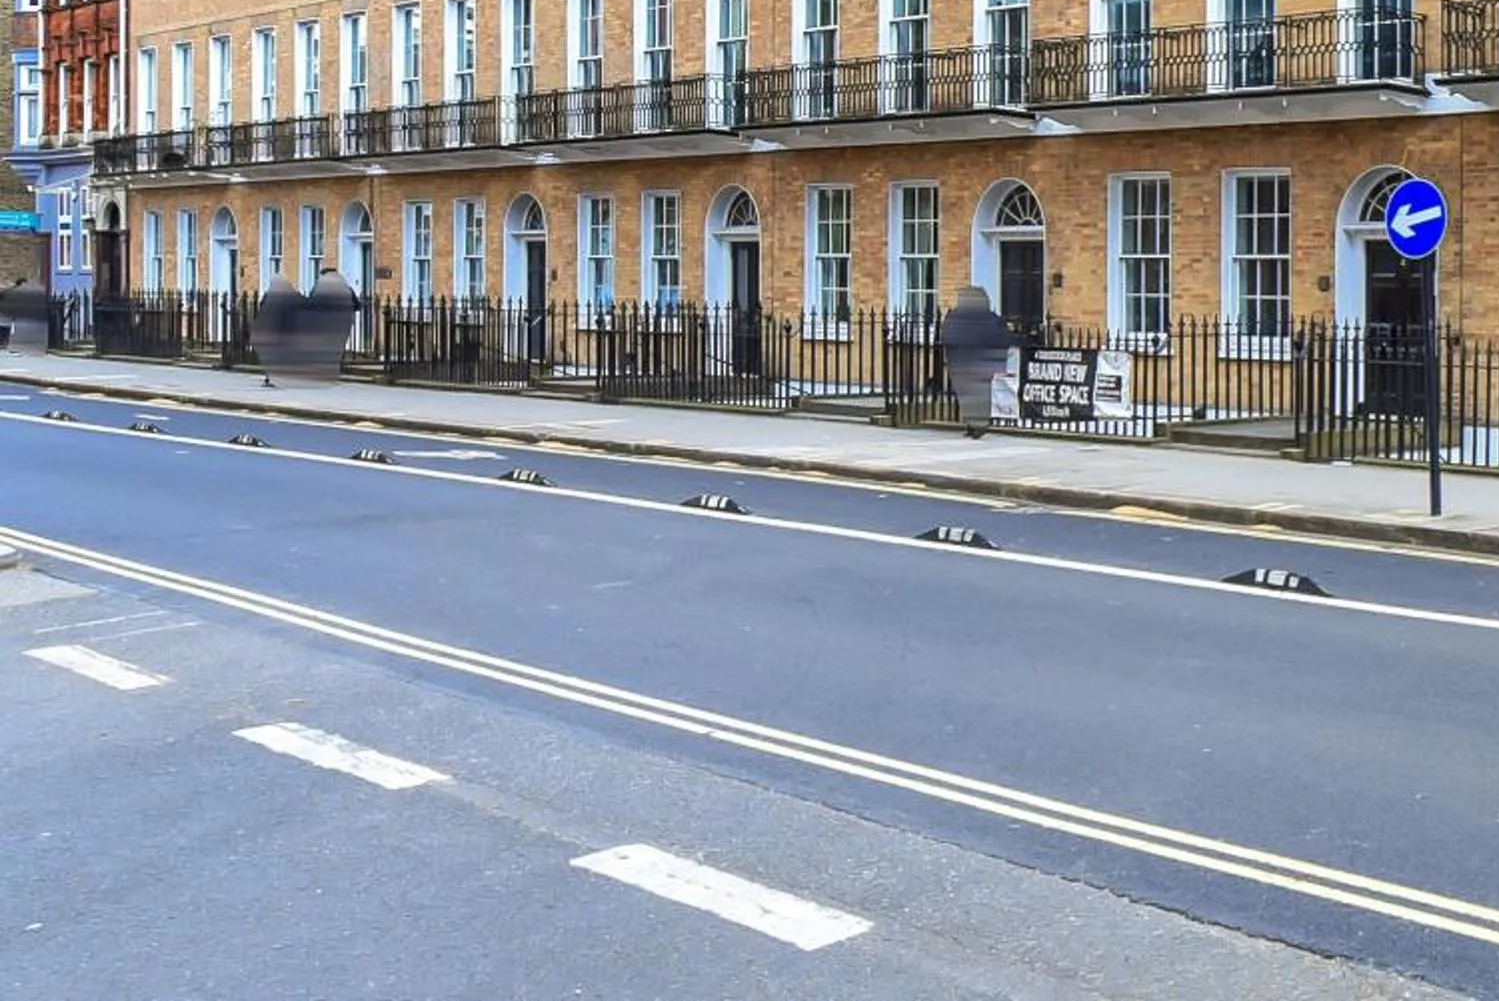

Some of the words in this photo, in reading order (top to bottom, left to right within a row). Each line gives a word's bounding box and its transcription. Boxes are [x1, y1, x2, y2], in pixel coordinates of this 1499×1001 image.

[1028, 361, 1062, 381] BRAND
[1063, 363, 1088, 383] NEW
[1023, 383, 1056, 403] OFFICE
[1058, 384, 1090, 405] SPACE
